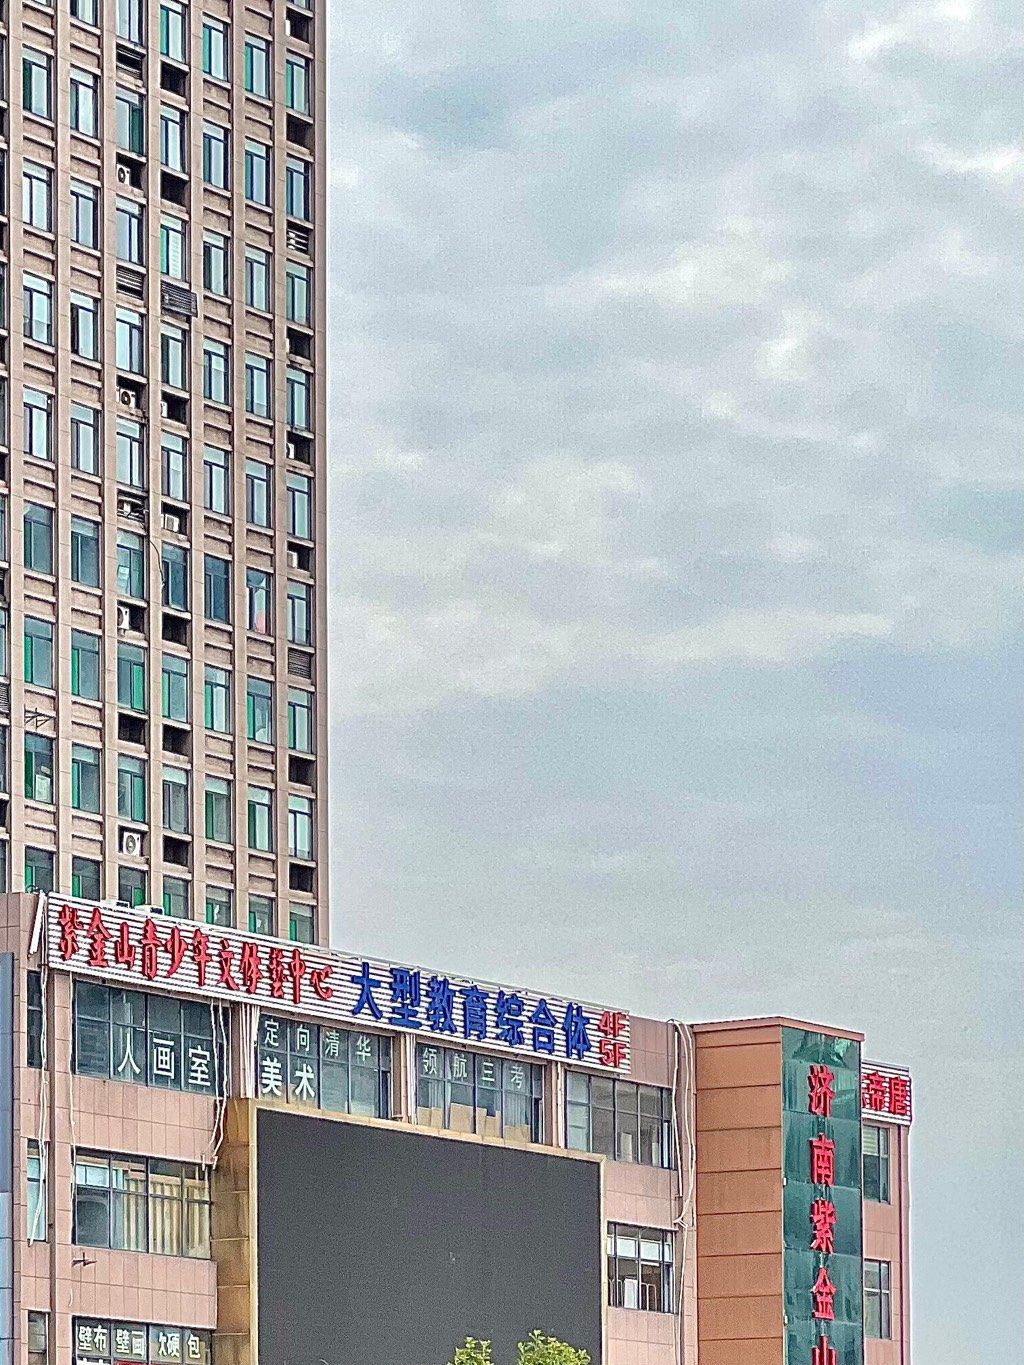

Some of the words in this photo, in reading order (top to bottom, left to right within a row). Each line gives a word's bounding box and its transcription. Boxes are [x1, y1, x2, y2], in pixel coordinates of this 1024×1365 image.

[351, 962, 592, 1060] 大型教育综合体
[598, 1010, 627, 1038] 4F
[264, 1018, 372, 1062] 定向清华
[598, 1039, 627, 1067] 5F
[262, 1056, 316, 1101] 美术
[422, 1047, 524, 1089] 领航三考
[861, 1071, 907, 1116] 帝唐
[78, 1325, 107, 1351] 壁布
[116, 1328, 145, 1356] 壁画
